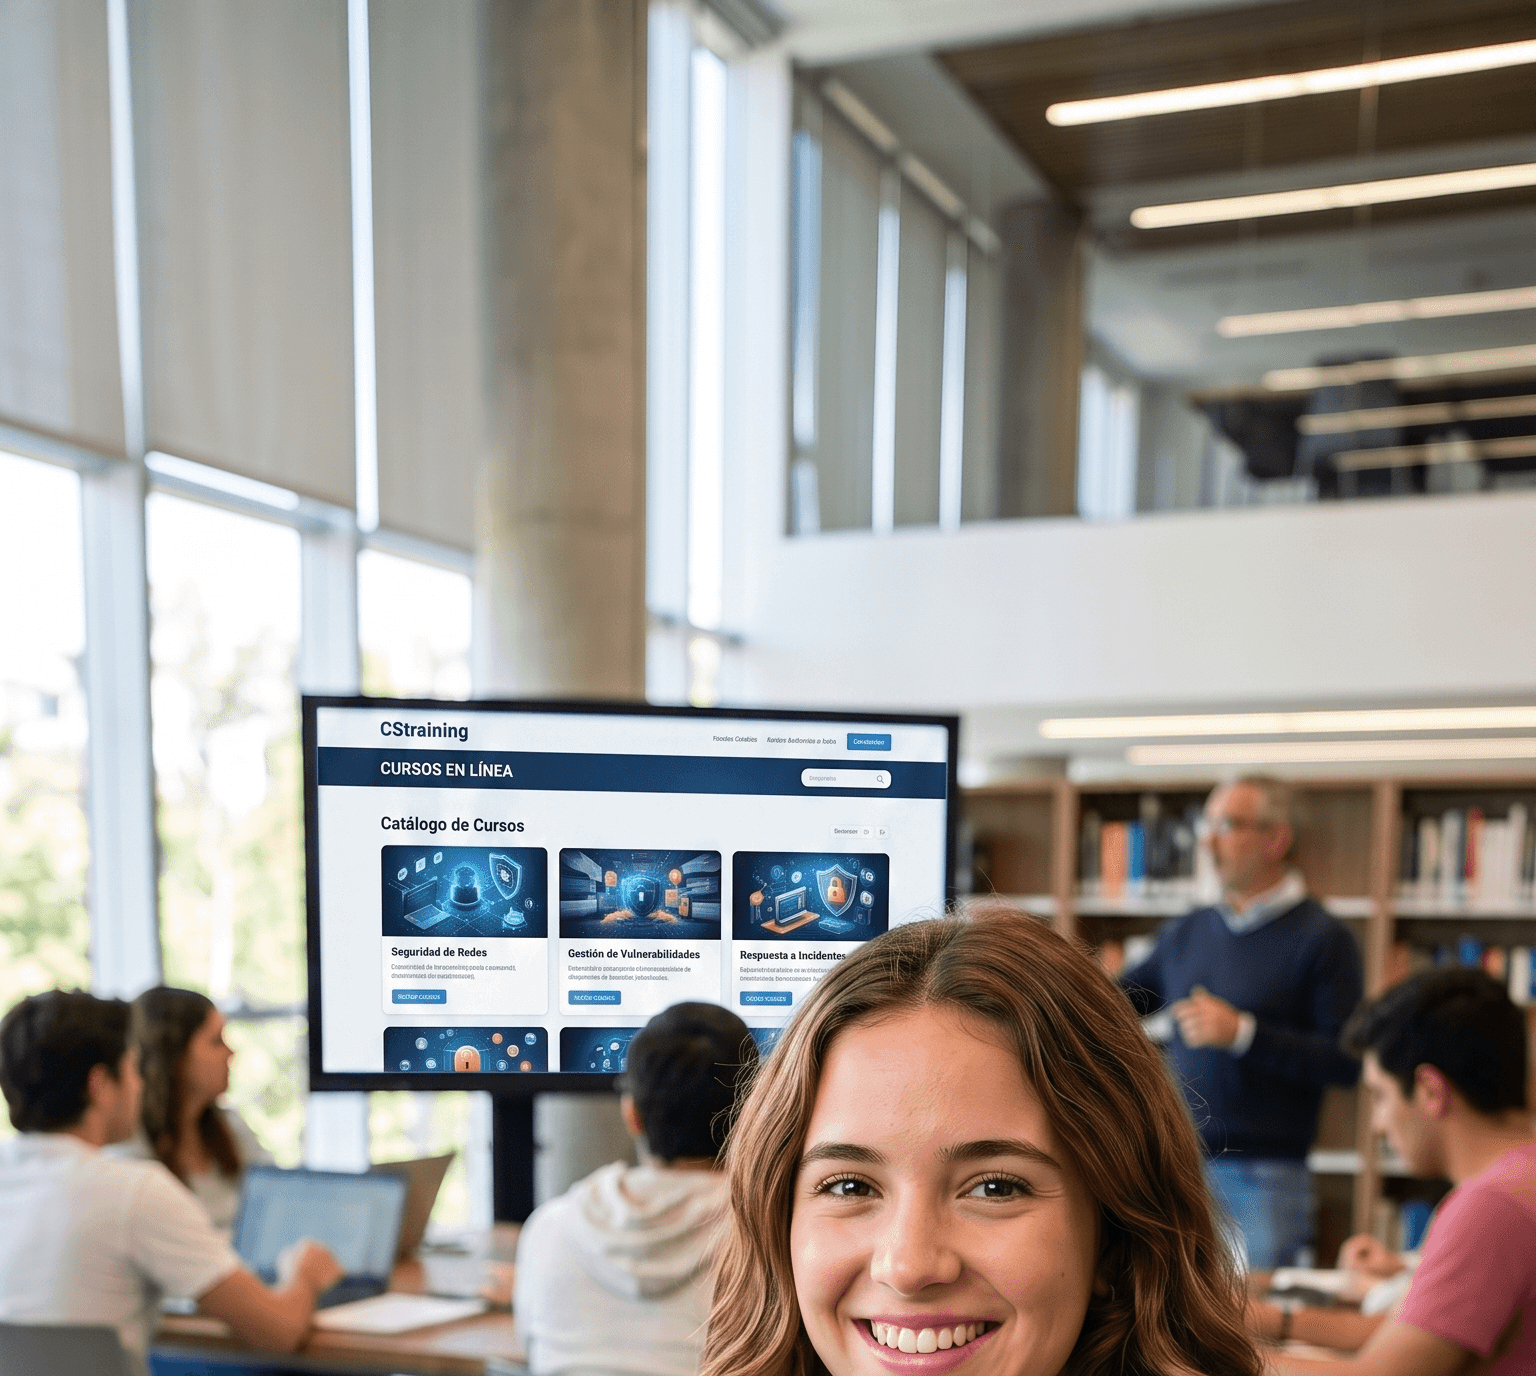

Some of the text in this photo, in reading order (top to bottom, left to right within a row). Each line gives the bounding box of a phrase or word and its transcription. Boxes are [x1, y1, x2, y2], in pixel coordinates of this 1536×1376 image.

[380, 721, 469, 742] CStraining
[380, 761, 514, 778] CURSOS EN LÍNEA
[381, 816, 525, 835] Catálogo de Cursos
[391, 947, 488, 959] Seguridad de Redes
[568, 948, 701, 960] Gestión de Vulnerabilidades
[740, 950, 789, 962] Respuesta
[798, 951, 847, 961] Incidentes
